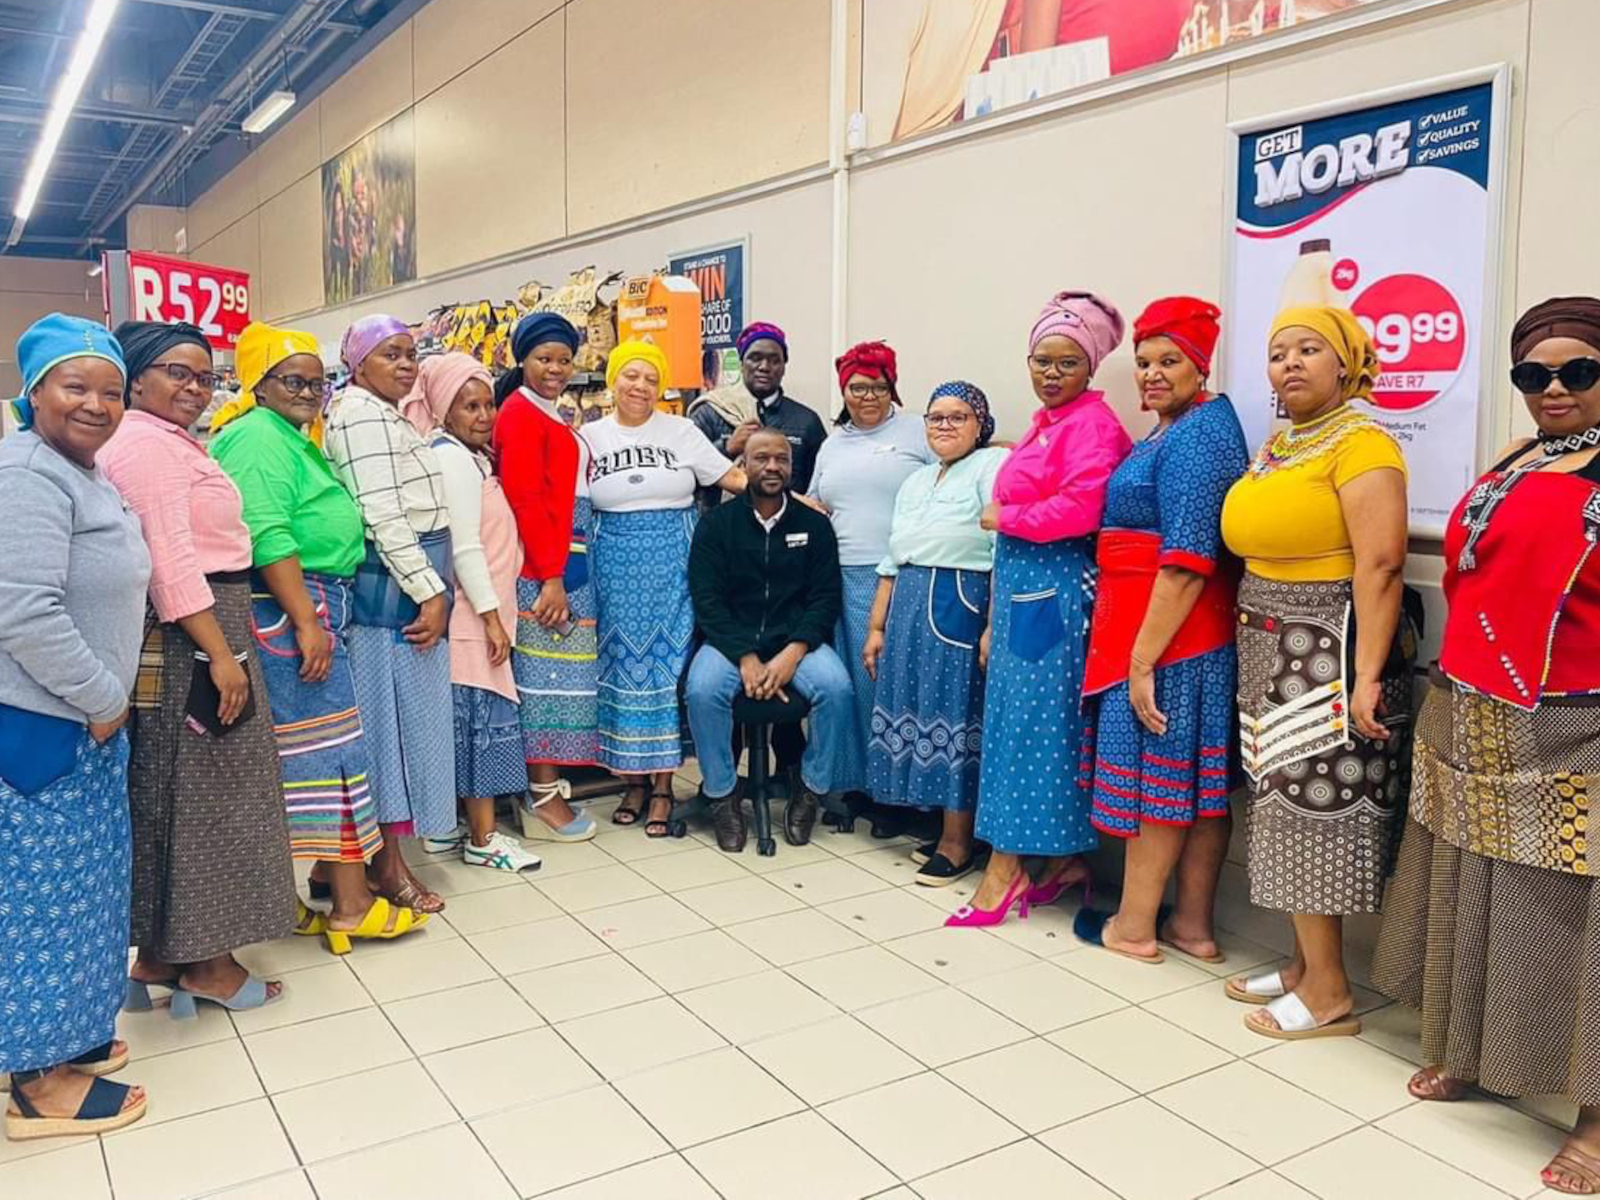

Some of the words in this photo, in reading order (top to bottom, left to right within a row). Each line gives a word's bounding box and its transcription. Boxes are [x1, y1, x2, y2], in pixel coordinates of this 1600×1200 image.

[1431, 105, 1469, 125] VALUE
[1428, 119, 1481, 143] QUALITY
[1258, 129, 1299, 158] GET
[1428, 138, 1480, 160] SAVINGS
[1254, 120, 1412, 207] MORE
[1374, 375, 1404, 388] AVE
[1406, 374, 1425, 388] R7
[1398, 431, 1413, 442] 2kg
[1412, 421, 1427, 431] Fat
